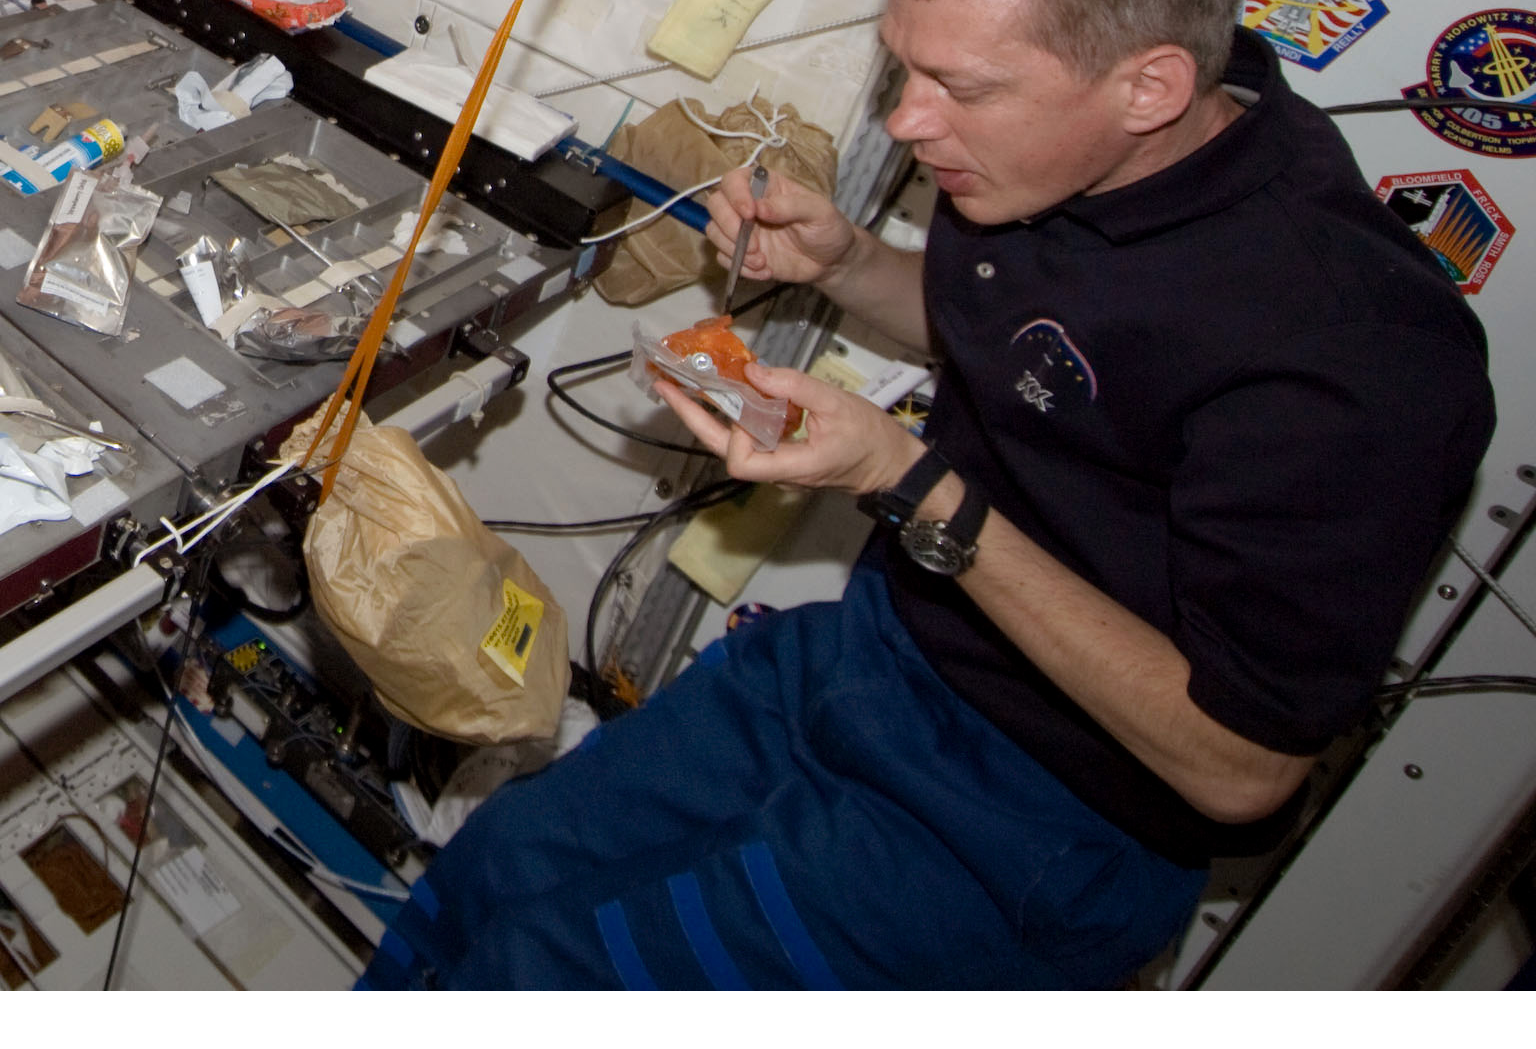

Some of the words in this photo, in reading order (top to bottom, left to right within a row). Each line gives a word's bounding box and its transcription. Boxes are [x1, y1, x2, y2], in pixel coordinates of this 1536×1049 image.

[1332, 23, 1366, 53] REILLY
[1431, 51, 1443, 87] BARRY
[1444, 12, 1509, 42] HOROWITZ
[1275, 44, 1302, 62] ANDI
[1391, 172, 1463, 186] BLOOMFIELD
[1473, 189, 1502, 222] FRICK
[1488, 231, 1509, 258] SMITH
[1472, 261, 1492, 285] ROSS
